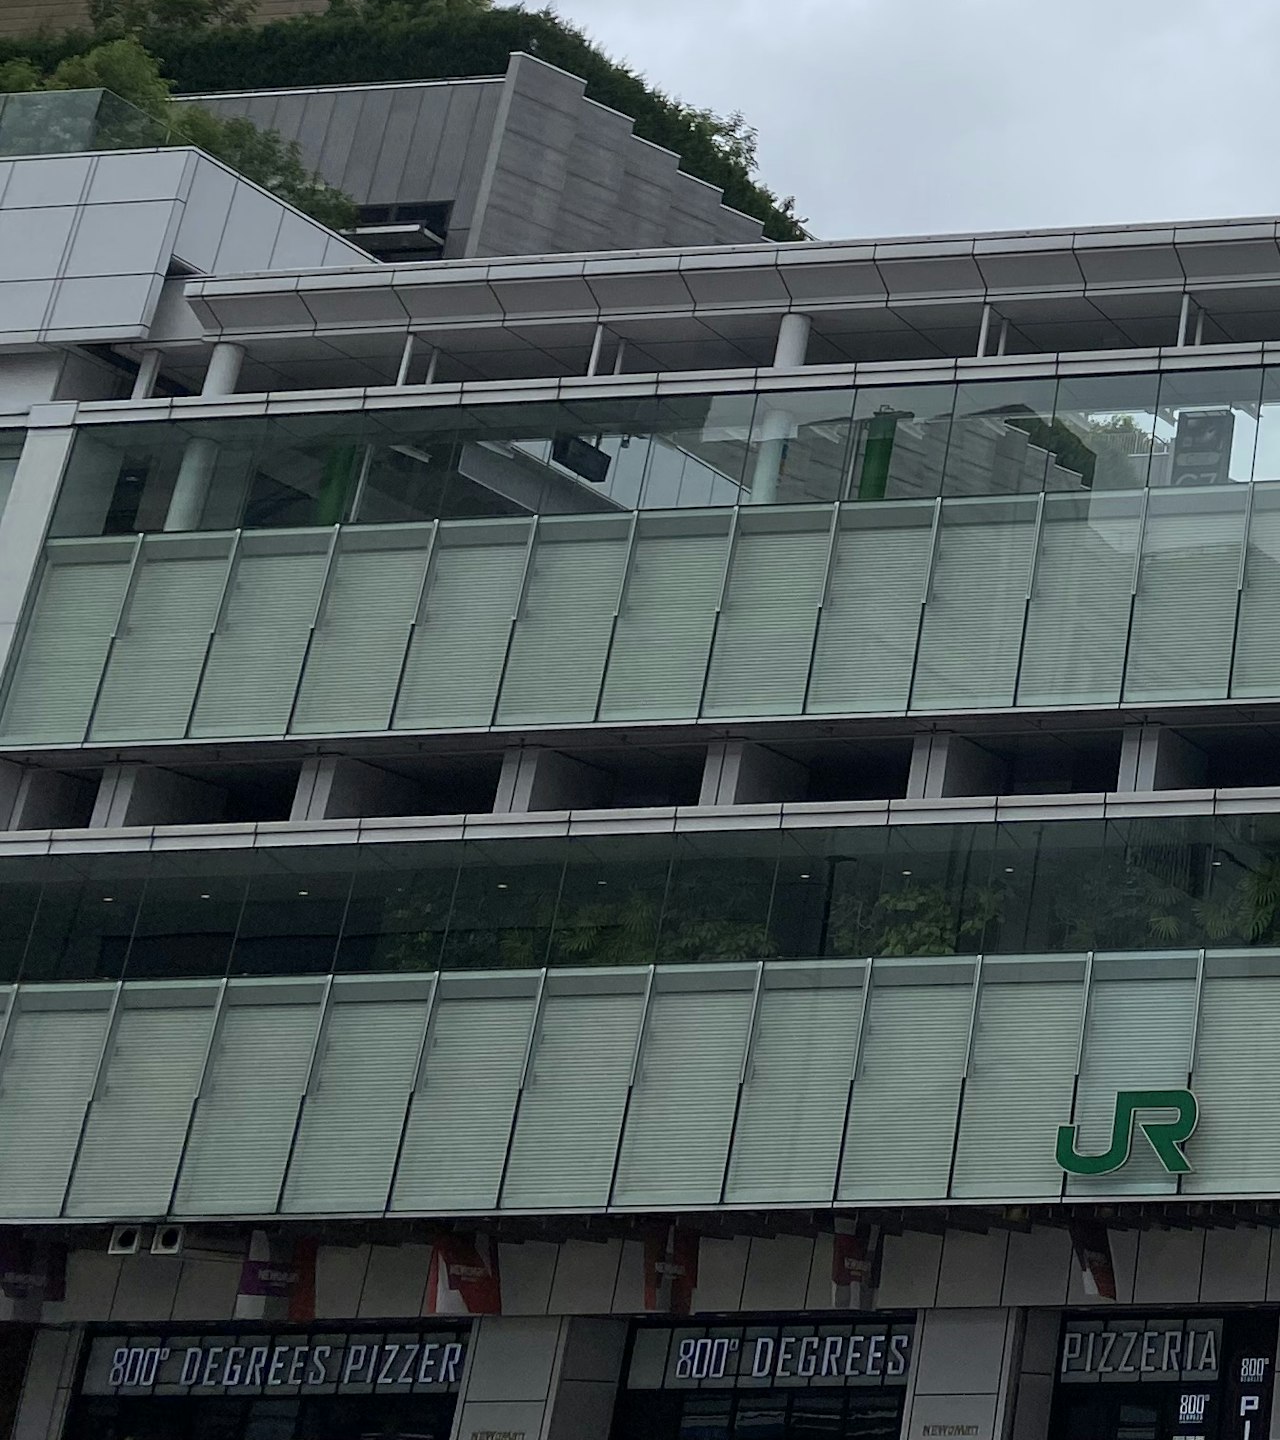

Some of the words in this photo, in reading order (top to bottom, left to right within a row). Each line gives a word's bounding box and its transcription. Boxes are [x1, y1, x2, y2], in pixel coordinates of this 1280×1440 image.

[1055, 1090, 1198, 1175] JR
[179, 1345, 331, 1386] DEGREES
[752, 1335, 909, 1377] DEGREES
[1061, 1330, 1217, 1373] PIZZERIA
